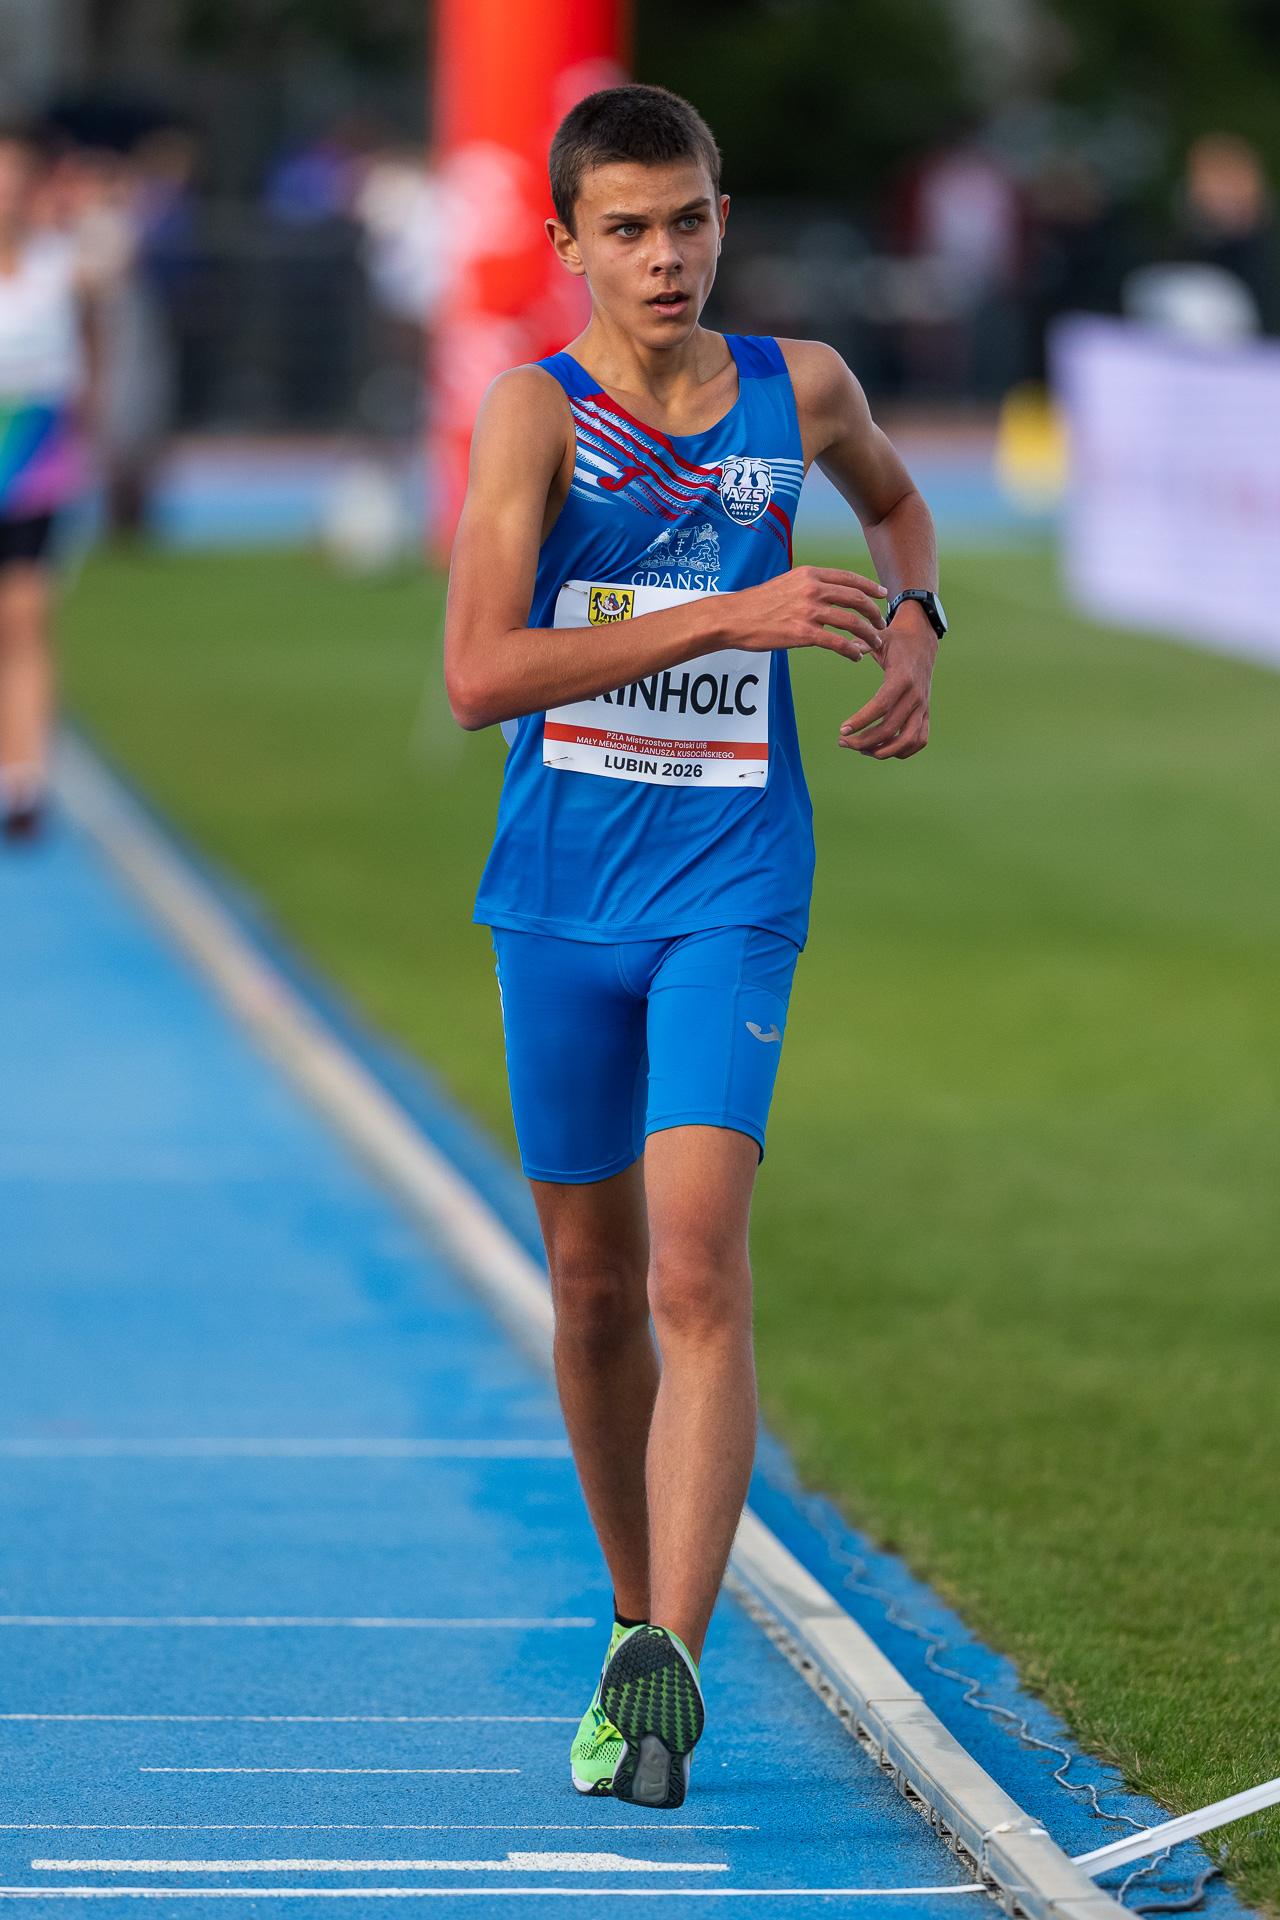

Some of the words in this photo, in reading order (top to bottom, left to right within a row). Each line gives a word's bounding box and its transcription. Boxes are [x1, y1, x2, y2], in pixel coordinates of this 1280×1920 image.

[727, 487, 764, 503] AZS
[631, 570, 720, 592] GDAŃSK
[587, 671, 759, 716] NHOLC
[576, 735, 598, 746] MAŁY
[598, 738, 638, 752] MEMORIAŁ
[639, 747, 676, 757] JANUSZA
[676, 749, 735, 759] KUSOCIŃSKIEGO
[606, 731, 624, 741] PZLA
[625, 735, 673, 748] Mistrzostwa
[674, 741, 695, 749] Polski
[604, 754, 658, 775] LUBIN
[661, 762, 703, 778] 2026
